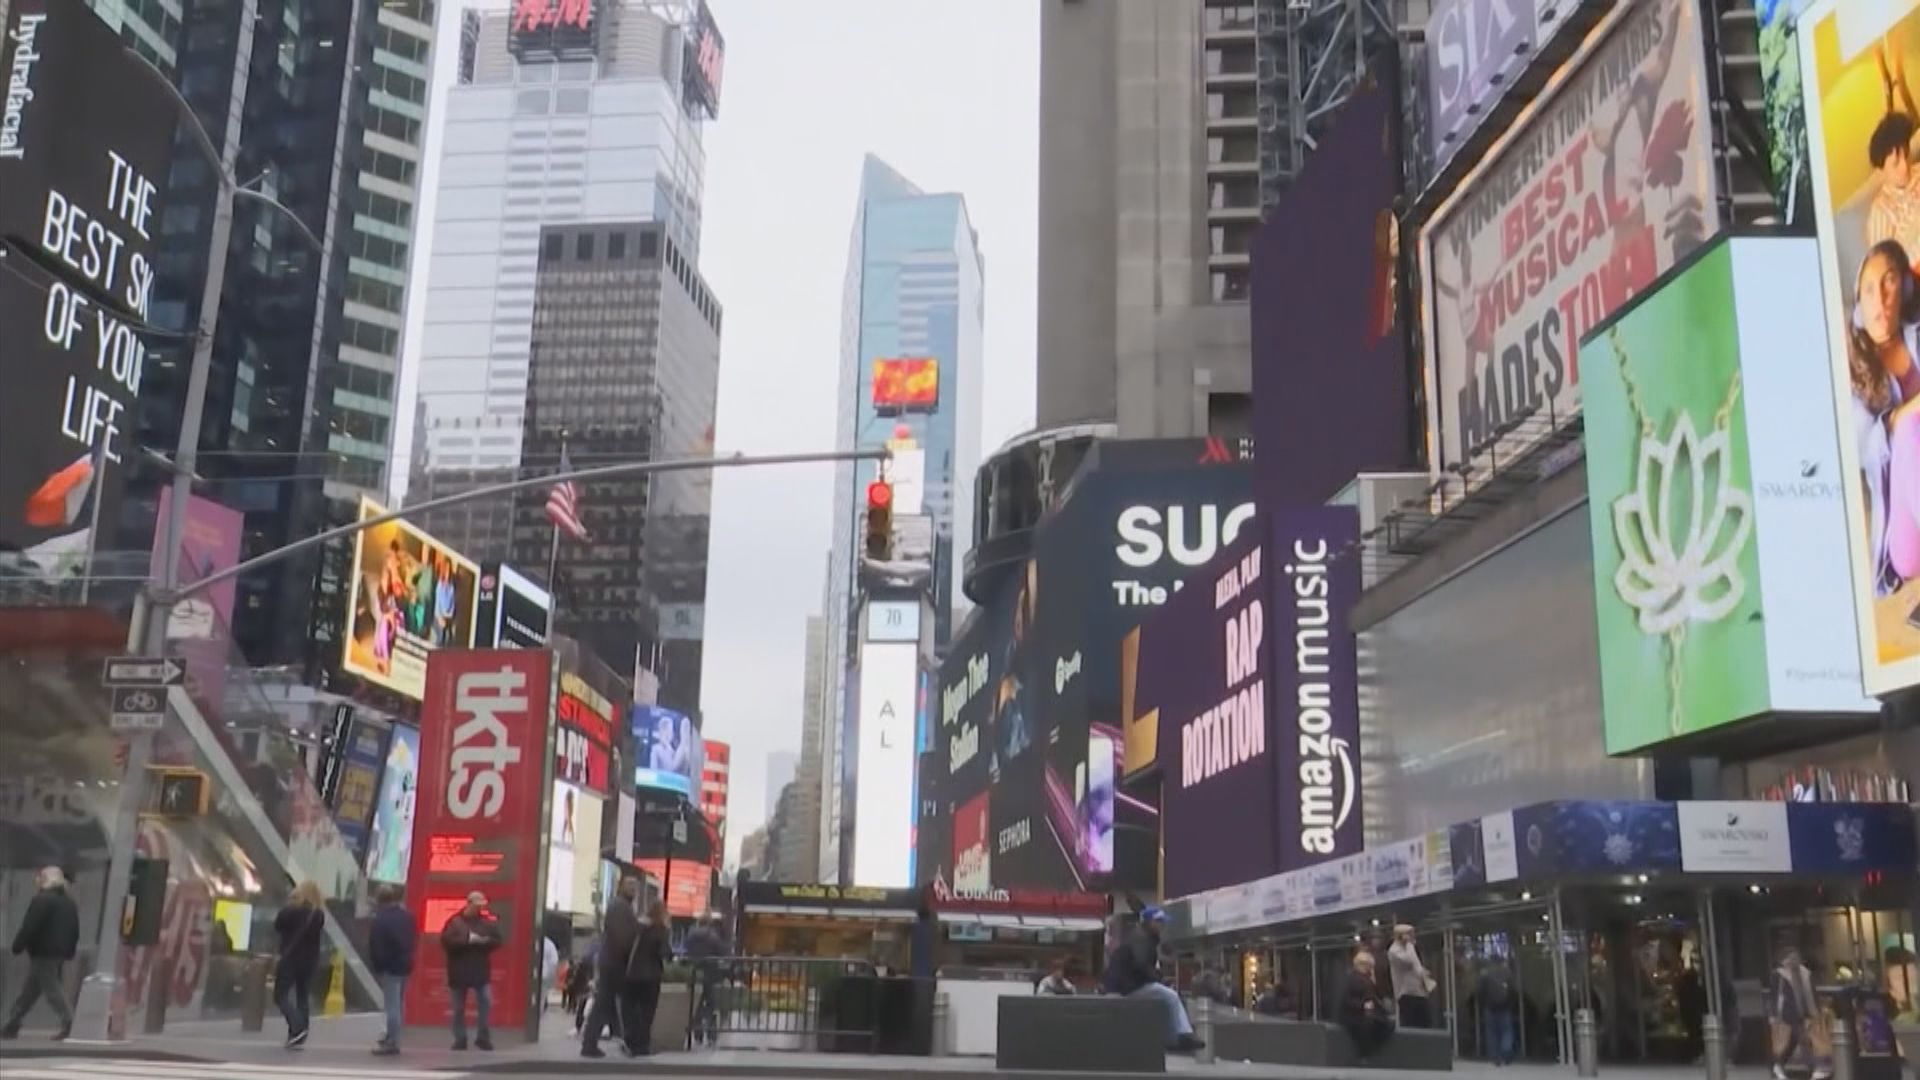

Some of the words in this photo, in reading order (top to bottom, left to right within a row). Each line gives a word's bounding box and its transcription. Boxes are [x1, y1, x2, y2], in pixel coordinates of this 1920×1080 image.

[42, 189, 125, 291] BEST
[107, 149, 157, 241] THE
[1502, 131, 1590, 261] BEST
[45, 281, 89, 350] OF
[1474, 192, 1632, 352] MUSICAL
[1111, 579, 1168, 606] The
[1226, 599, 1264, 688] RAP
[1284, 539, 1330, 674] music
[447, 664, 529, 820] tkts
[1182, 679, 1265, 789] ROTATION
[1298, 683, 1337, 854] amazon
[998, 815, 1031, 855] SEPHORA
